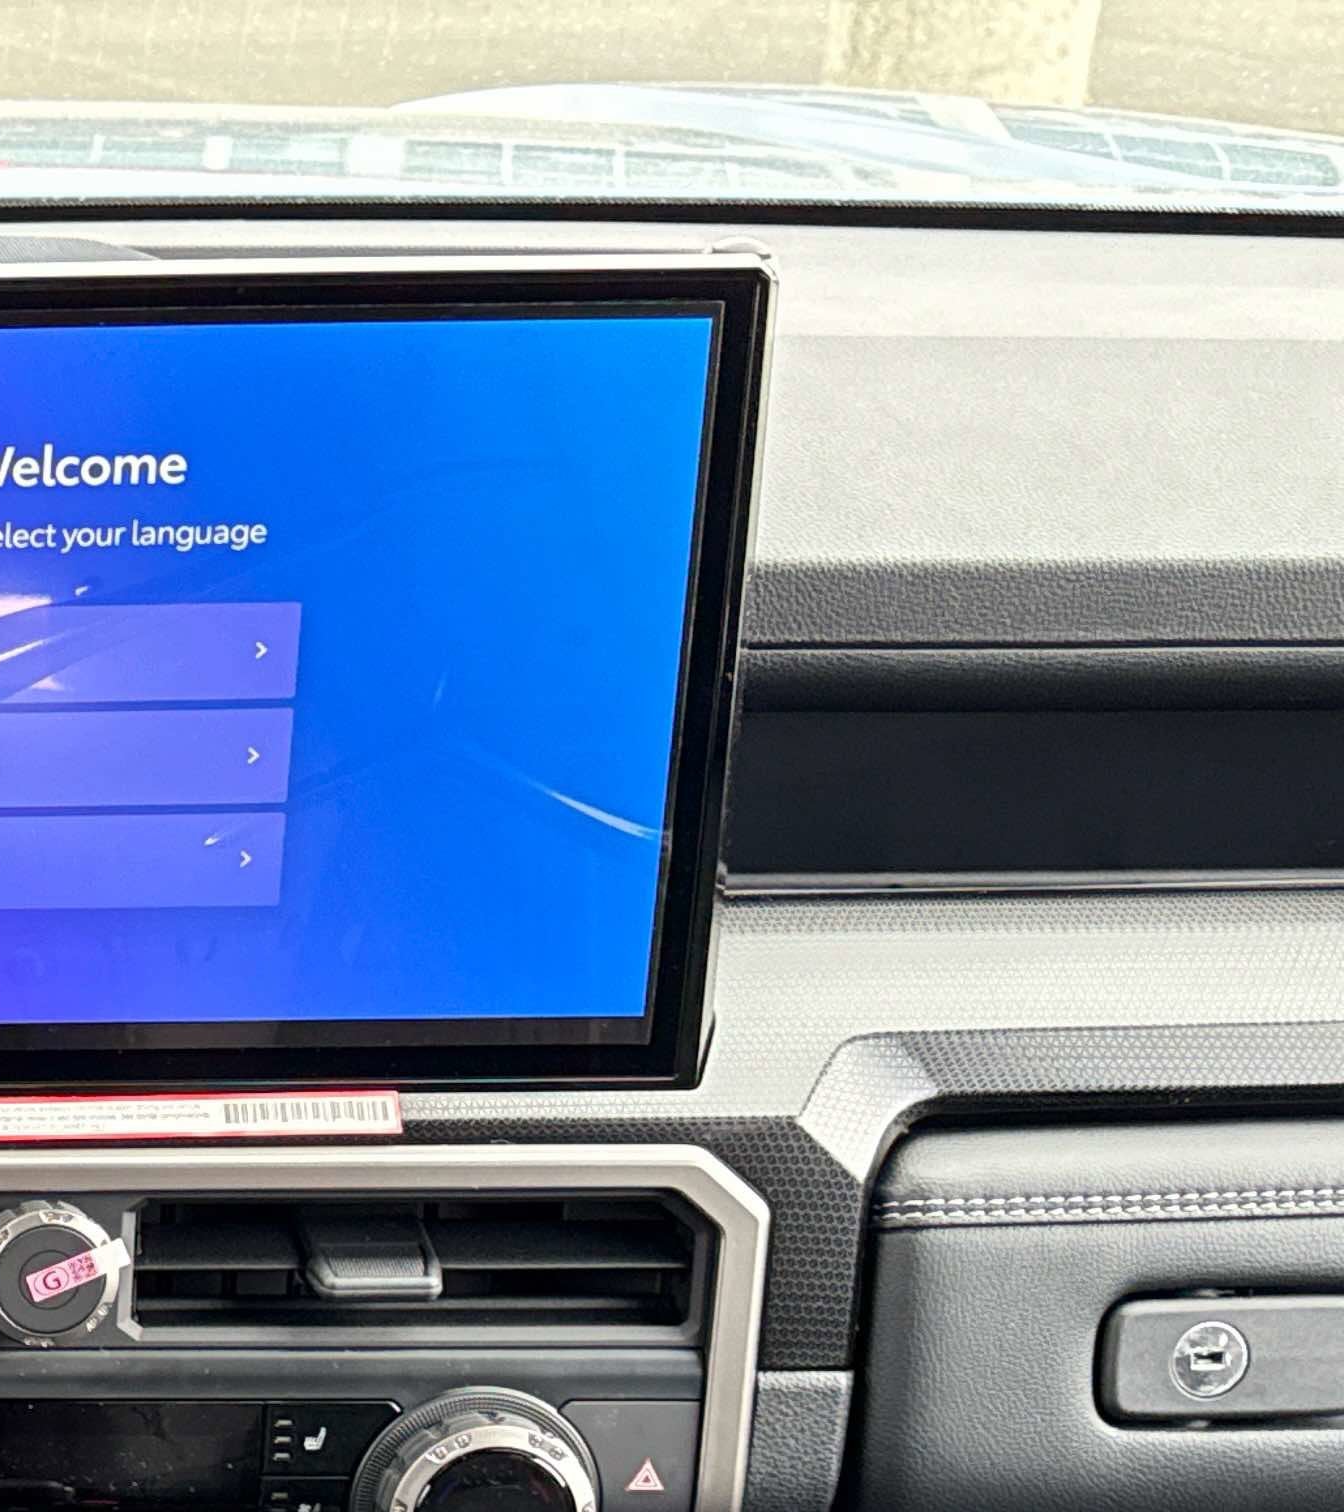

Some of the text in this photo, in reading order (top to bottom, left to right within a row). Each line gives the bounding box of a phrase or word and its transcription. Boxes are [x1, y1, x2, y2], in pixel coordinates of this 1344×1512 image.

[60, 526, 127, 554] your
[131, 519, 269, 552] language
[42, 1271, 62, 1291] G
